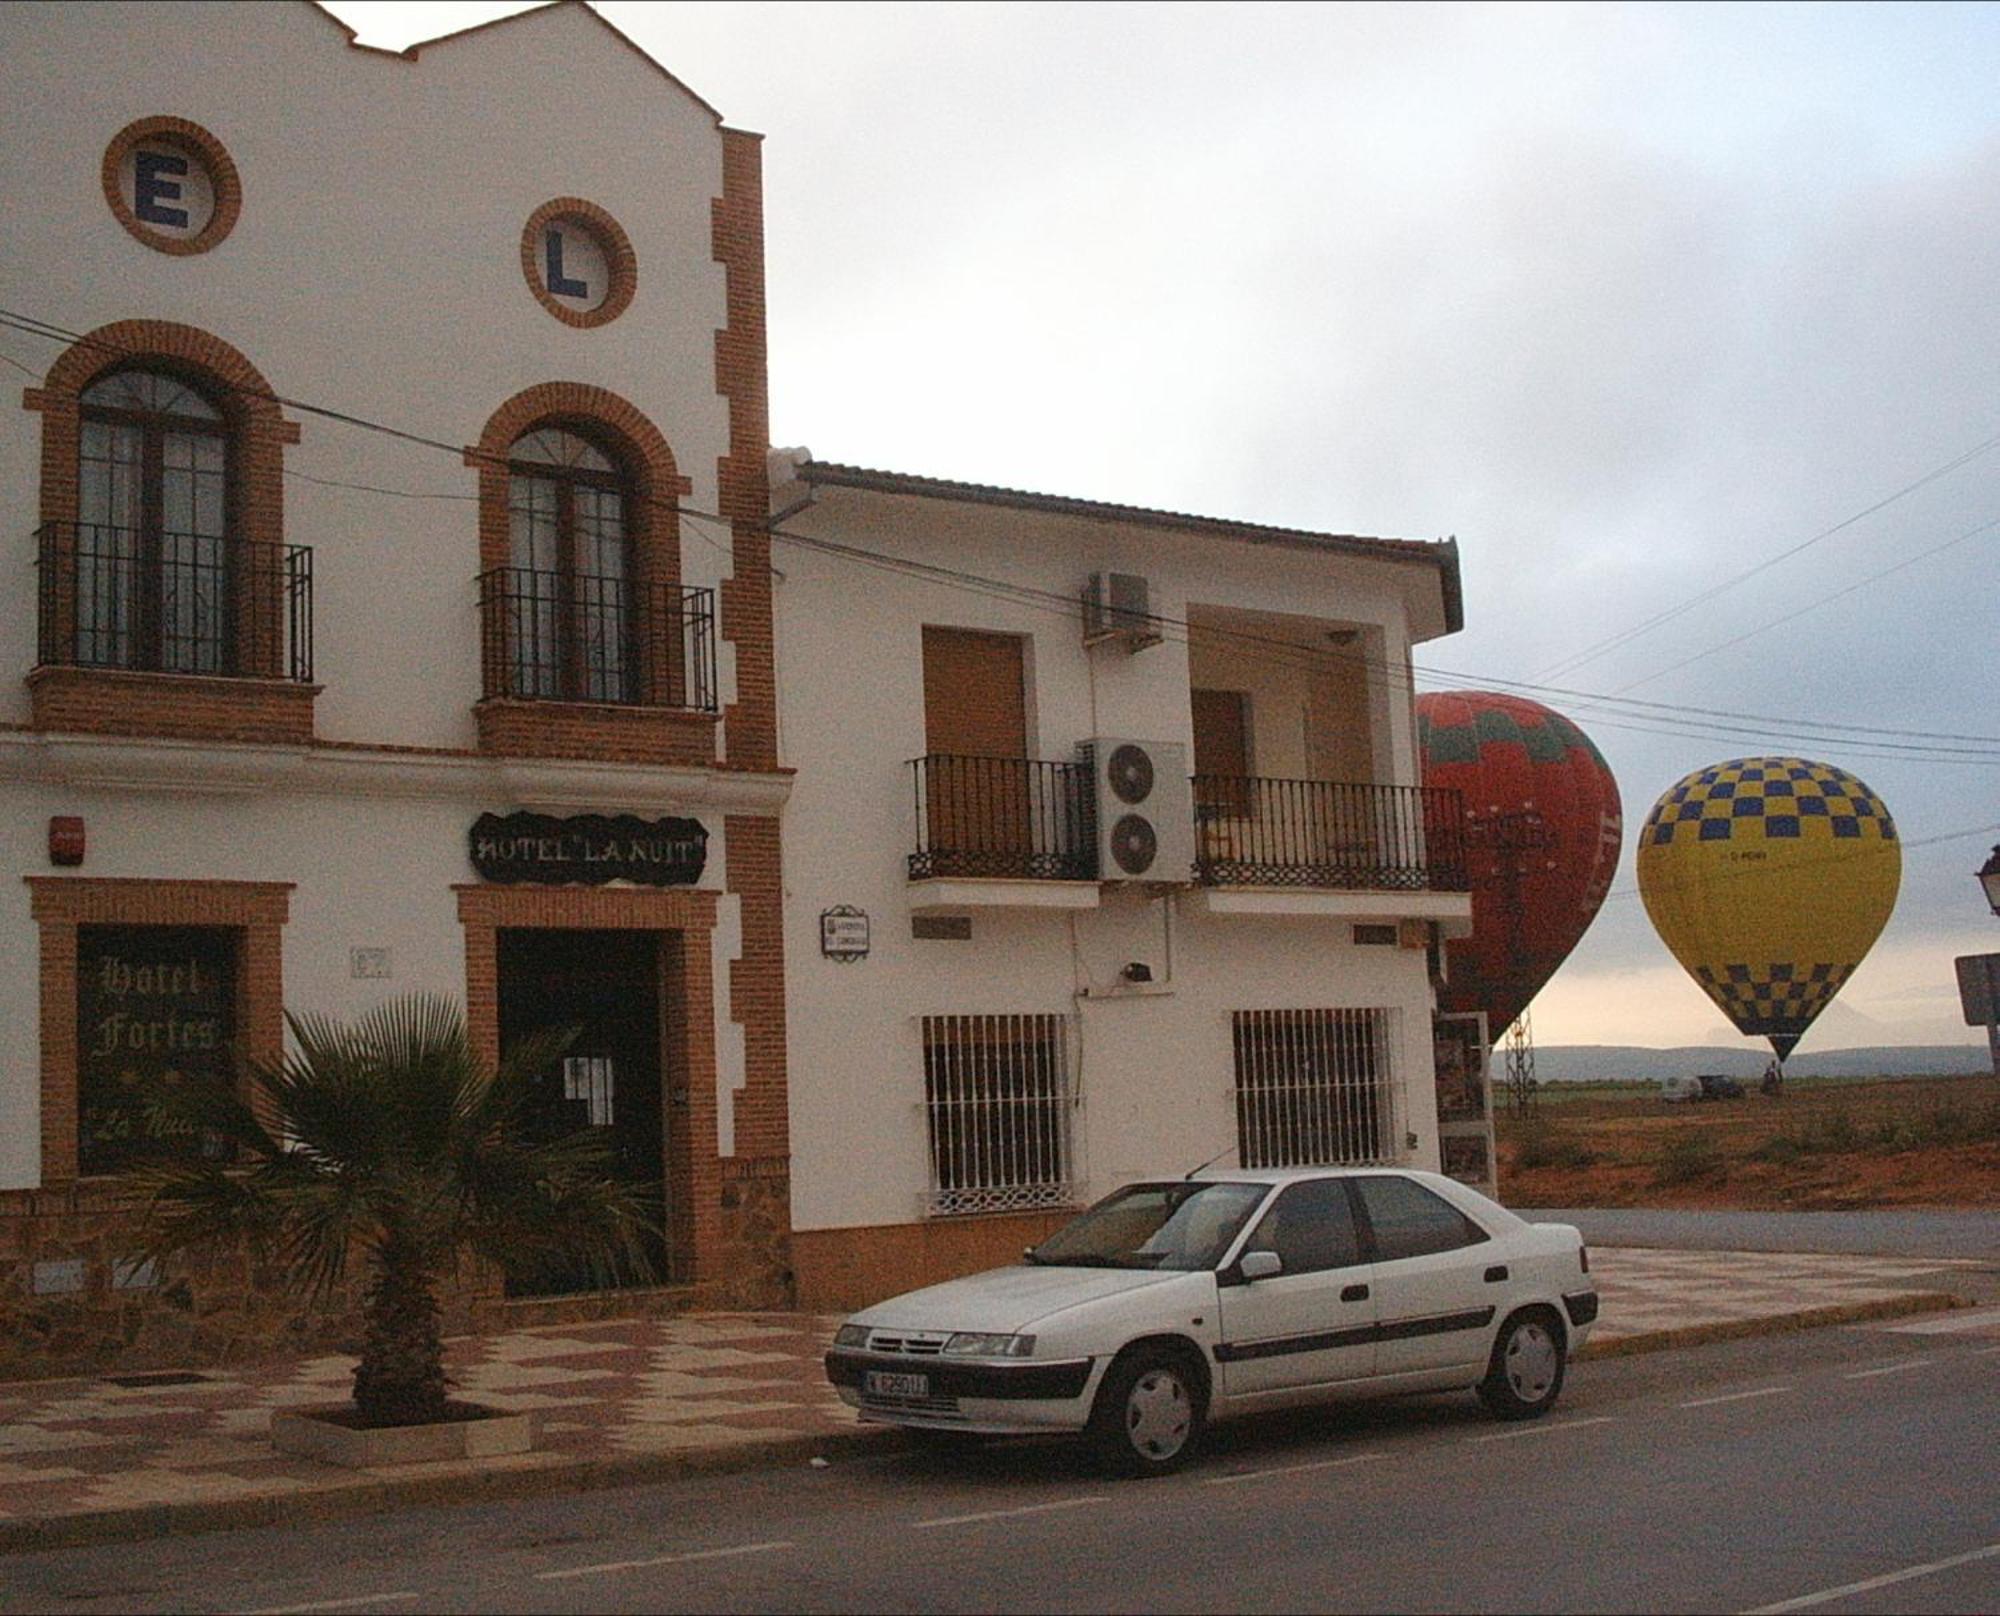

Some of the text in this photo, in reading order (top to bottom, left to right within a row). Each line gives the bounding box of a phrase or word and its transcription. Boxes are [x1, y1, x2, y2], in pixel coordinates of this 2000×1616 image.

[135, 151, 587, 299] E L
[478, 836, 570, 861] HOTEL
[98, 956, 200, 996] Hotel
[91, 1010, 216, 1057] Fortes
